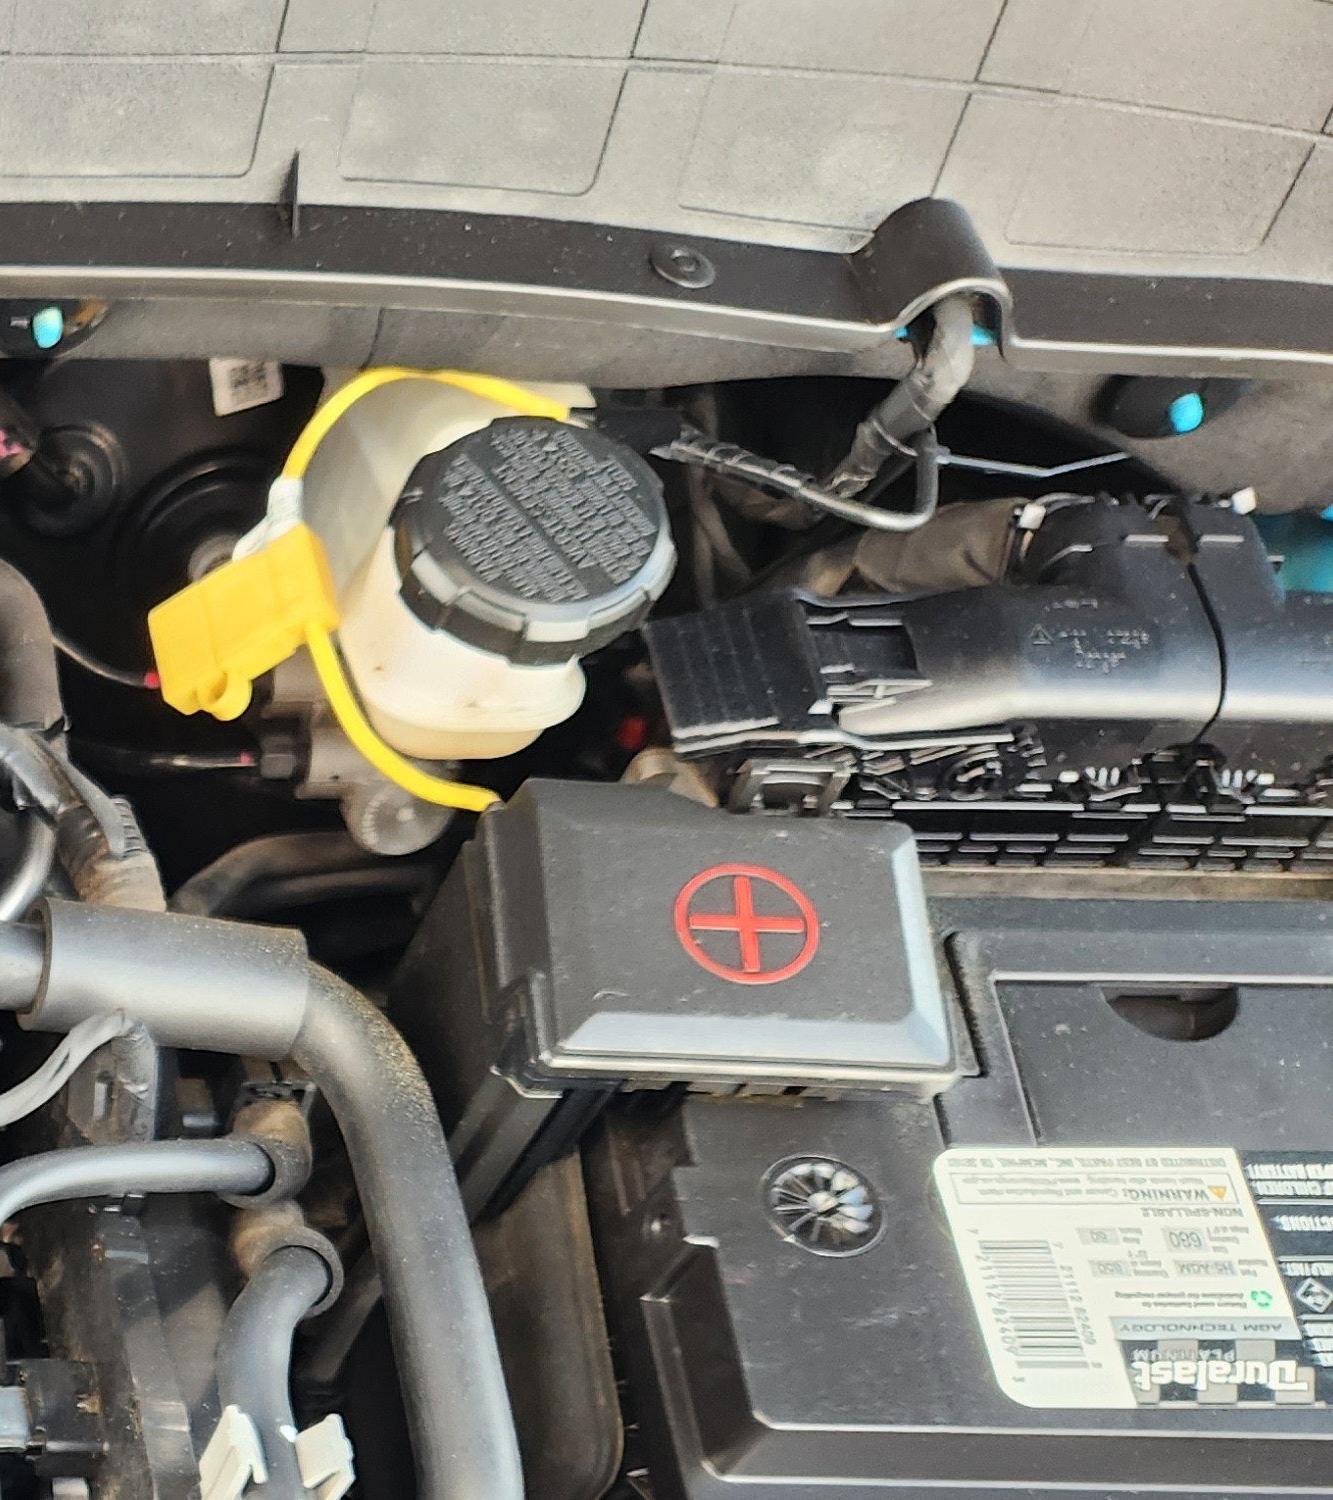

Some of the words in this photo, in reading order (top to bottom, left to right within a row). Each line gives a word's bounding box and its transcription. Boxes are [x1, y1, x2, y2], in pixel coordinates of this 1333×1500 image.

[1122, 1188, 1209, 1201] WARNING:
[1169, 1231, 1203, 1250] 680
[1119, 1322, 1238, 1333] TECHNOLOGY
[1243, 1322, 1283, 1333] AGM
[1132, 1348, 1236, 1361] PLATINUM
[1131, 1359, 1309, 1392] Duralast
